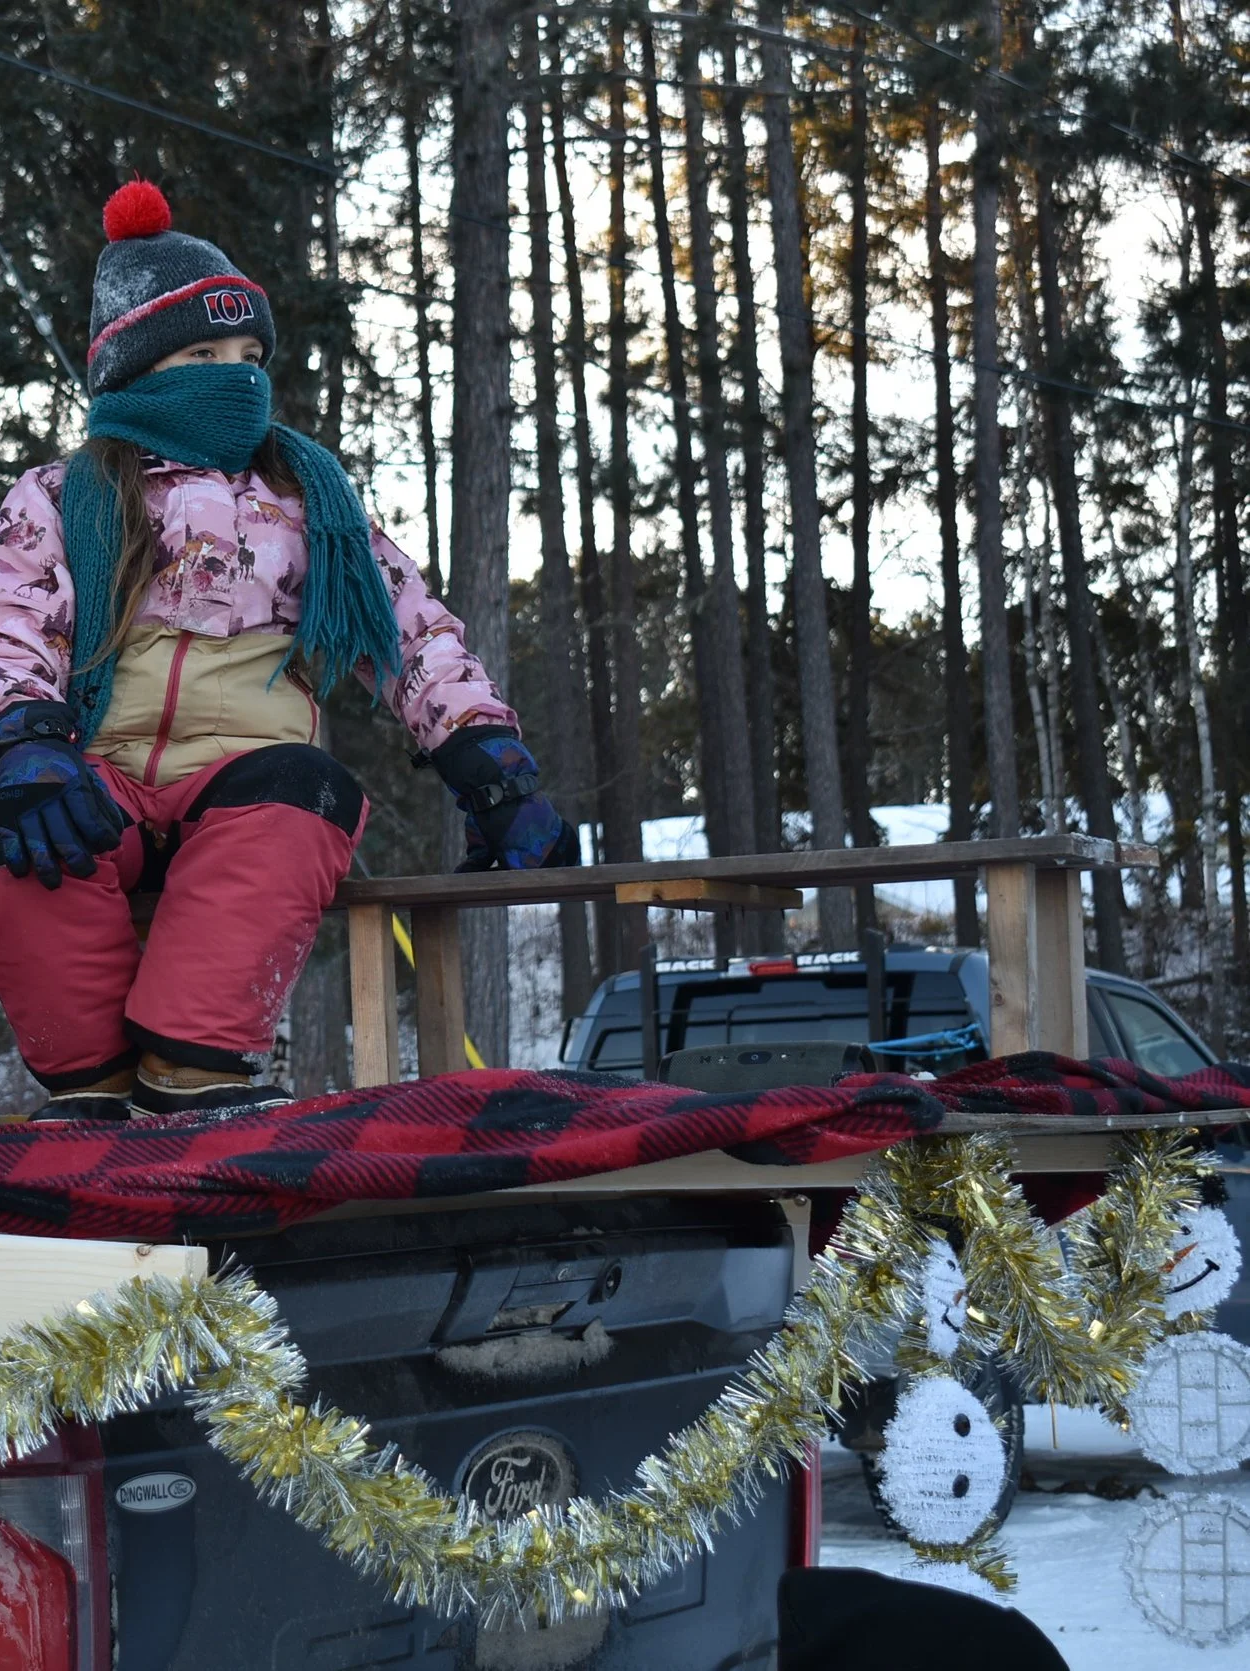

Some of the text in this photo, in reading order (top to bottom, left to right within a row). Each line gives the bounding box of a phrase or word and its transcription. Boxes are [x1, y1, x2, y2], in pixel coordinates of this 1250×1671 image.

[655, 951, 860, 973] BACK RACK
[484, 1455, 547, 1518] Ford
